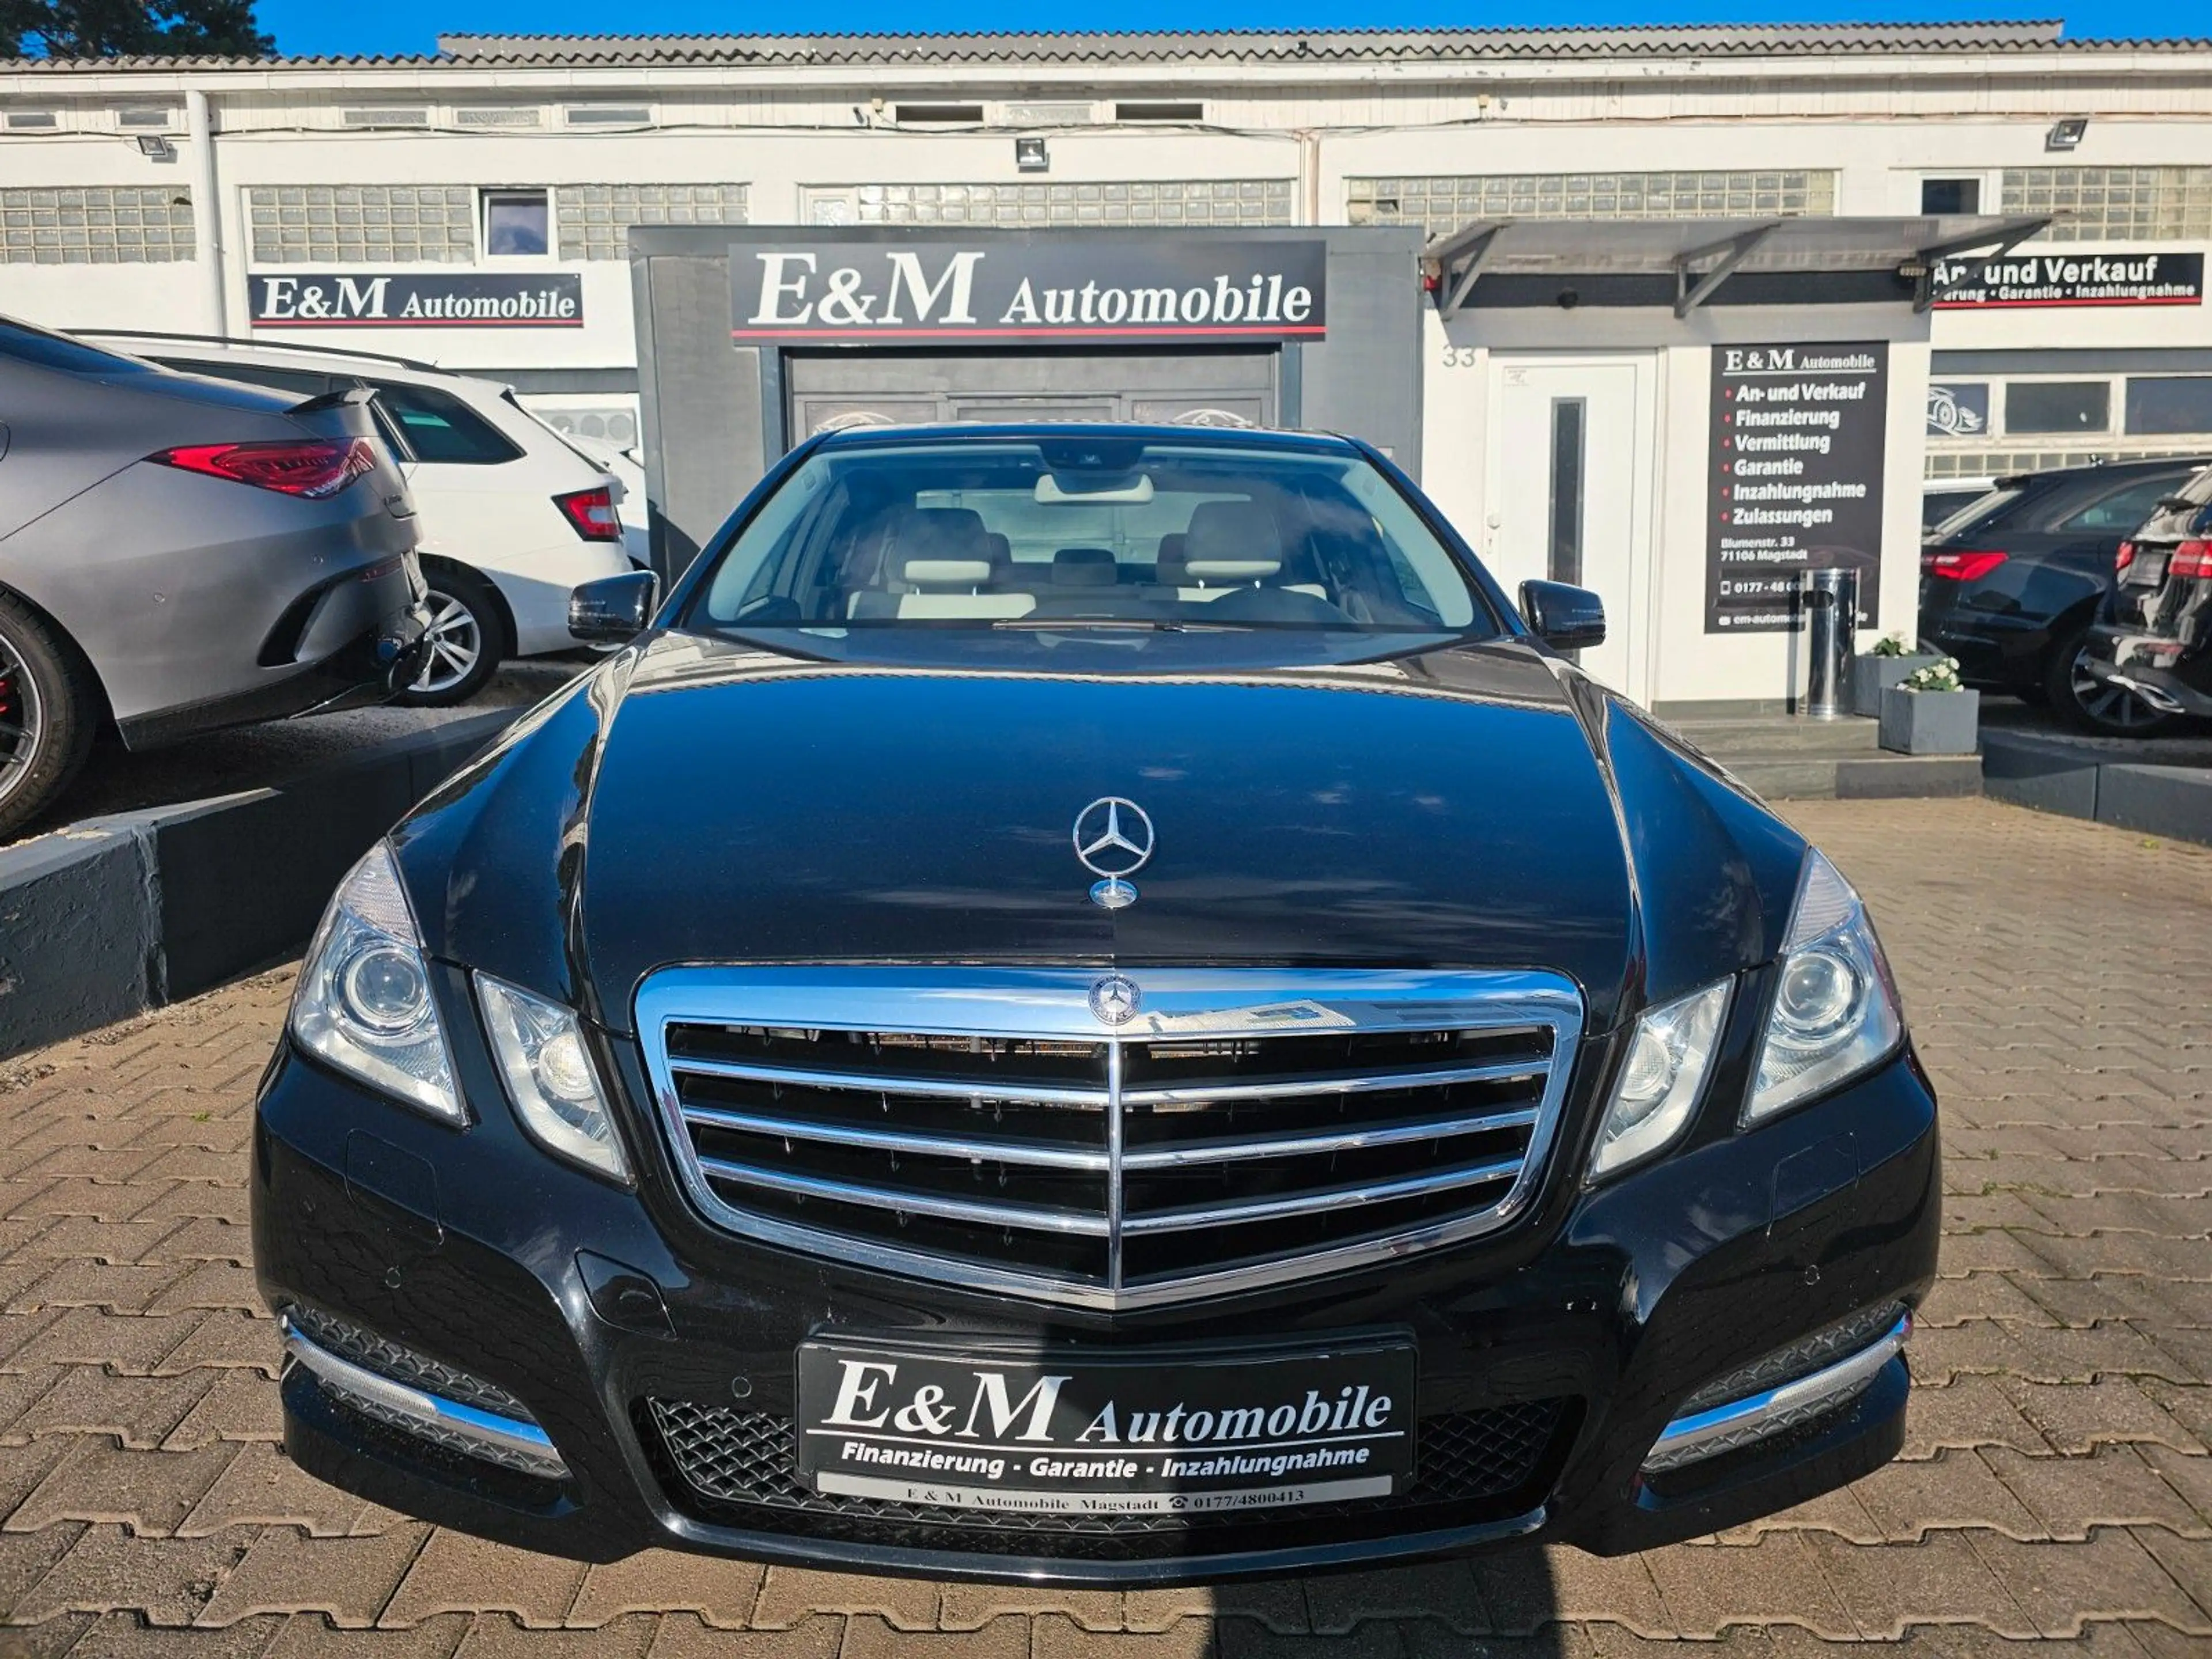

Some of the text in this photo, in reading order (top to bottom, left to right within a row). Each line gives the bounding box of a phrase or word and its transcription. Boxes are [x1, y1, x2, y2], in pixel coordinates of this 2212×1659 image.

[1984, 259, 2037, 285] und
[2045, 256, 2158, 283] Verkauf
[259, 277, 575, 319] E&M Automobile
[747, 251, 1311, 325] E&M Automobile
[1999, 285, 2062, 300] Garantie
[2075, 281, 2196, 300] Inzahlungnahme
[1442, 343, 1476, 368] 33
[1725, 349, 1876, 372] E & M Automobile
[1767, 384, 1799, 401] und
[1801, 381, 1866, 400] Verkauf
[1736, 408, 1840, 429] Finanzierung
[1734, 433, 1831, 454] Vermittlung
[1734, 458, 1804, 476] Garantie
[1733, 481, 1866, 503] Inzahlungnahme
[1733, 507, 1833, 528] Zulassungen
[1780, 536, 1796, 547] 33
[1721, 549, 1808, 562] 71106 Magstadt
[1734, 581, 1761, 593] 0177
[821, 1358, 1391, 1444] E&M Automobile
[841, 1441, 1006, 1479] Finanzierung
[1029, 1457, 1138, 1478] Garantie
[1161, 1446, 1370, 1478] Inzahlungnahme
[907, 1487, 1305, 1512] E & M Automobile Magstadt 0177/4800413
